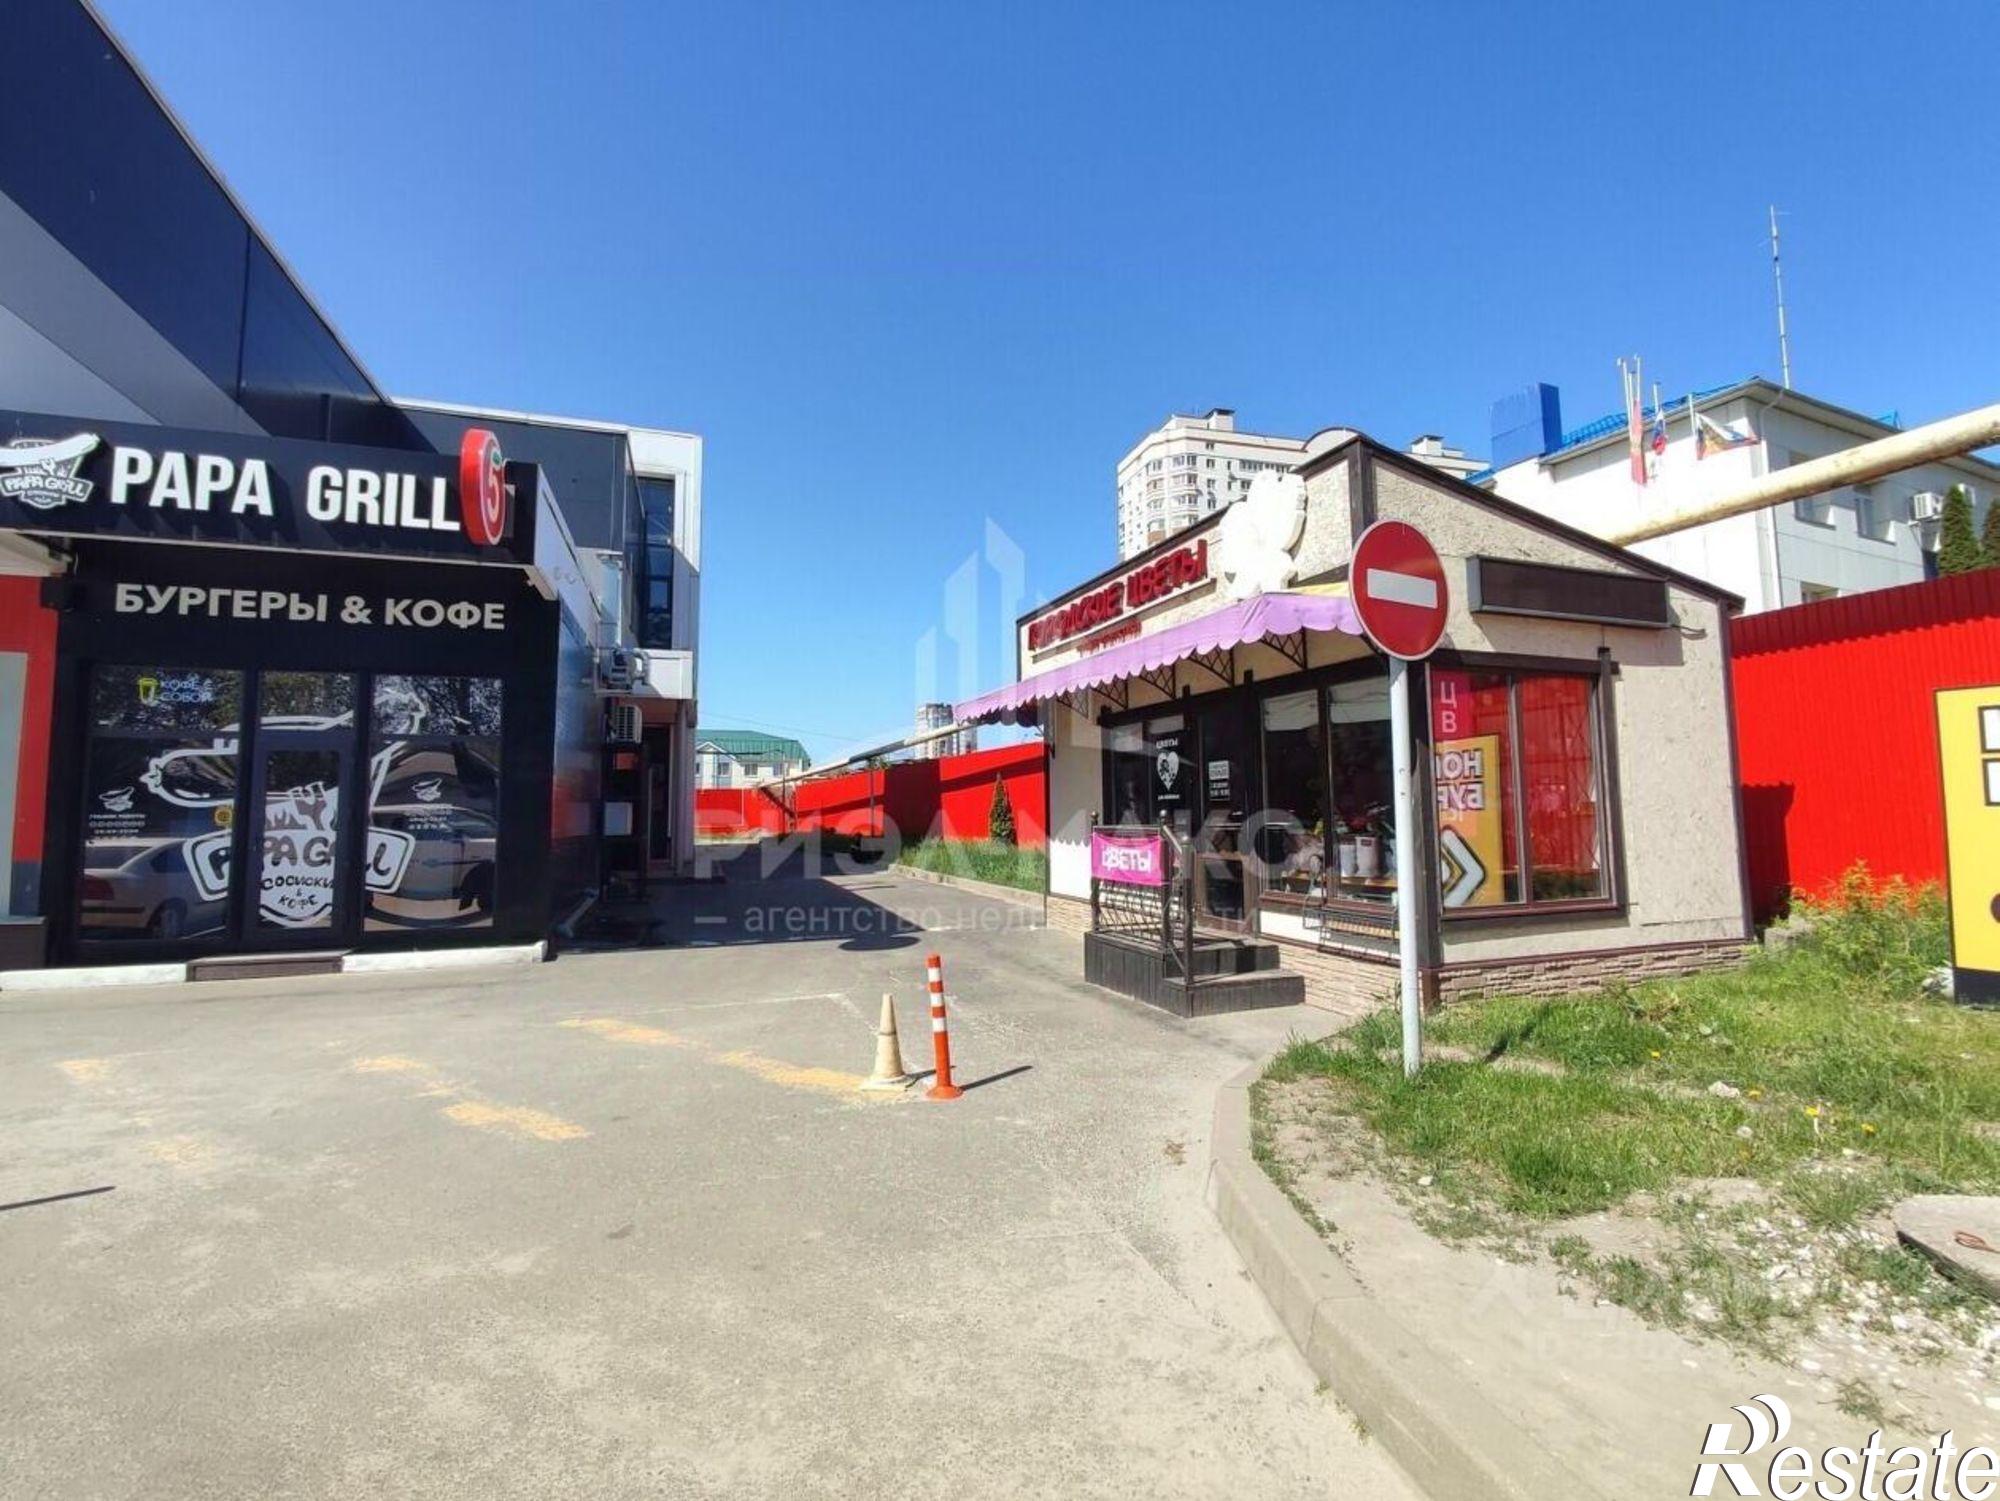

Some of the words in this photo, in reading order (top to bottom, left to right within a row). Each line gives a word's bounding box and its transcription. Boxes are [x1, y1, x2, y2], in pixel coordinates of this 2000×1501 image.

[110, 446, 274, 516] PAPA
[306, 465, 461, 532] GRILL
[115, 583, 328, 622] БУРГЕРЫ
[340, 595, 373, 625] &
[385, 598, 506, 630] КОФЕ
[1102, 846, 1152, 874] ЦВЕТЫ
